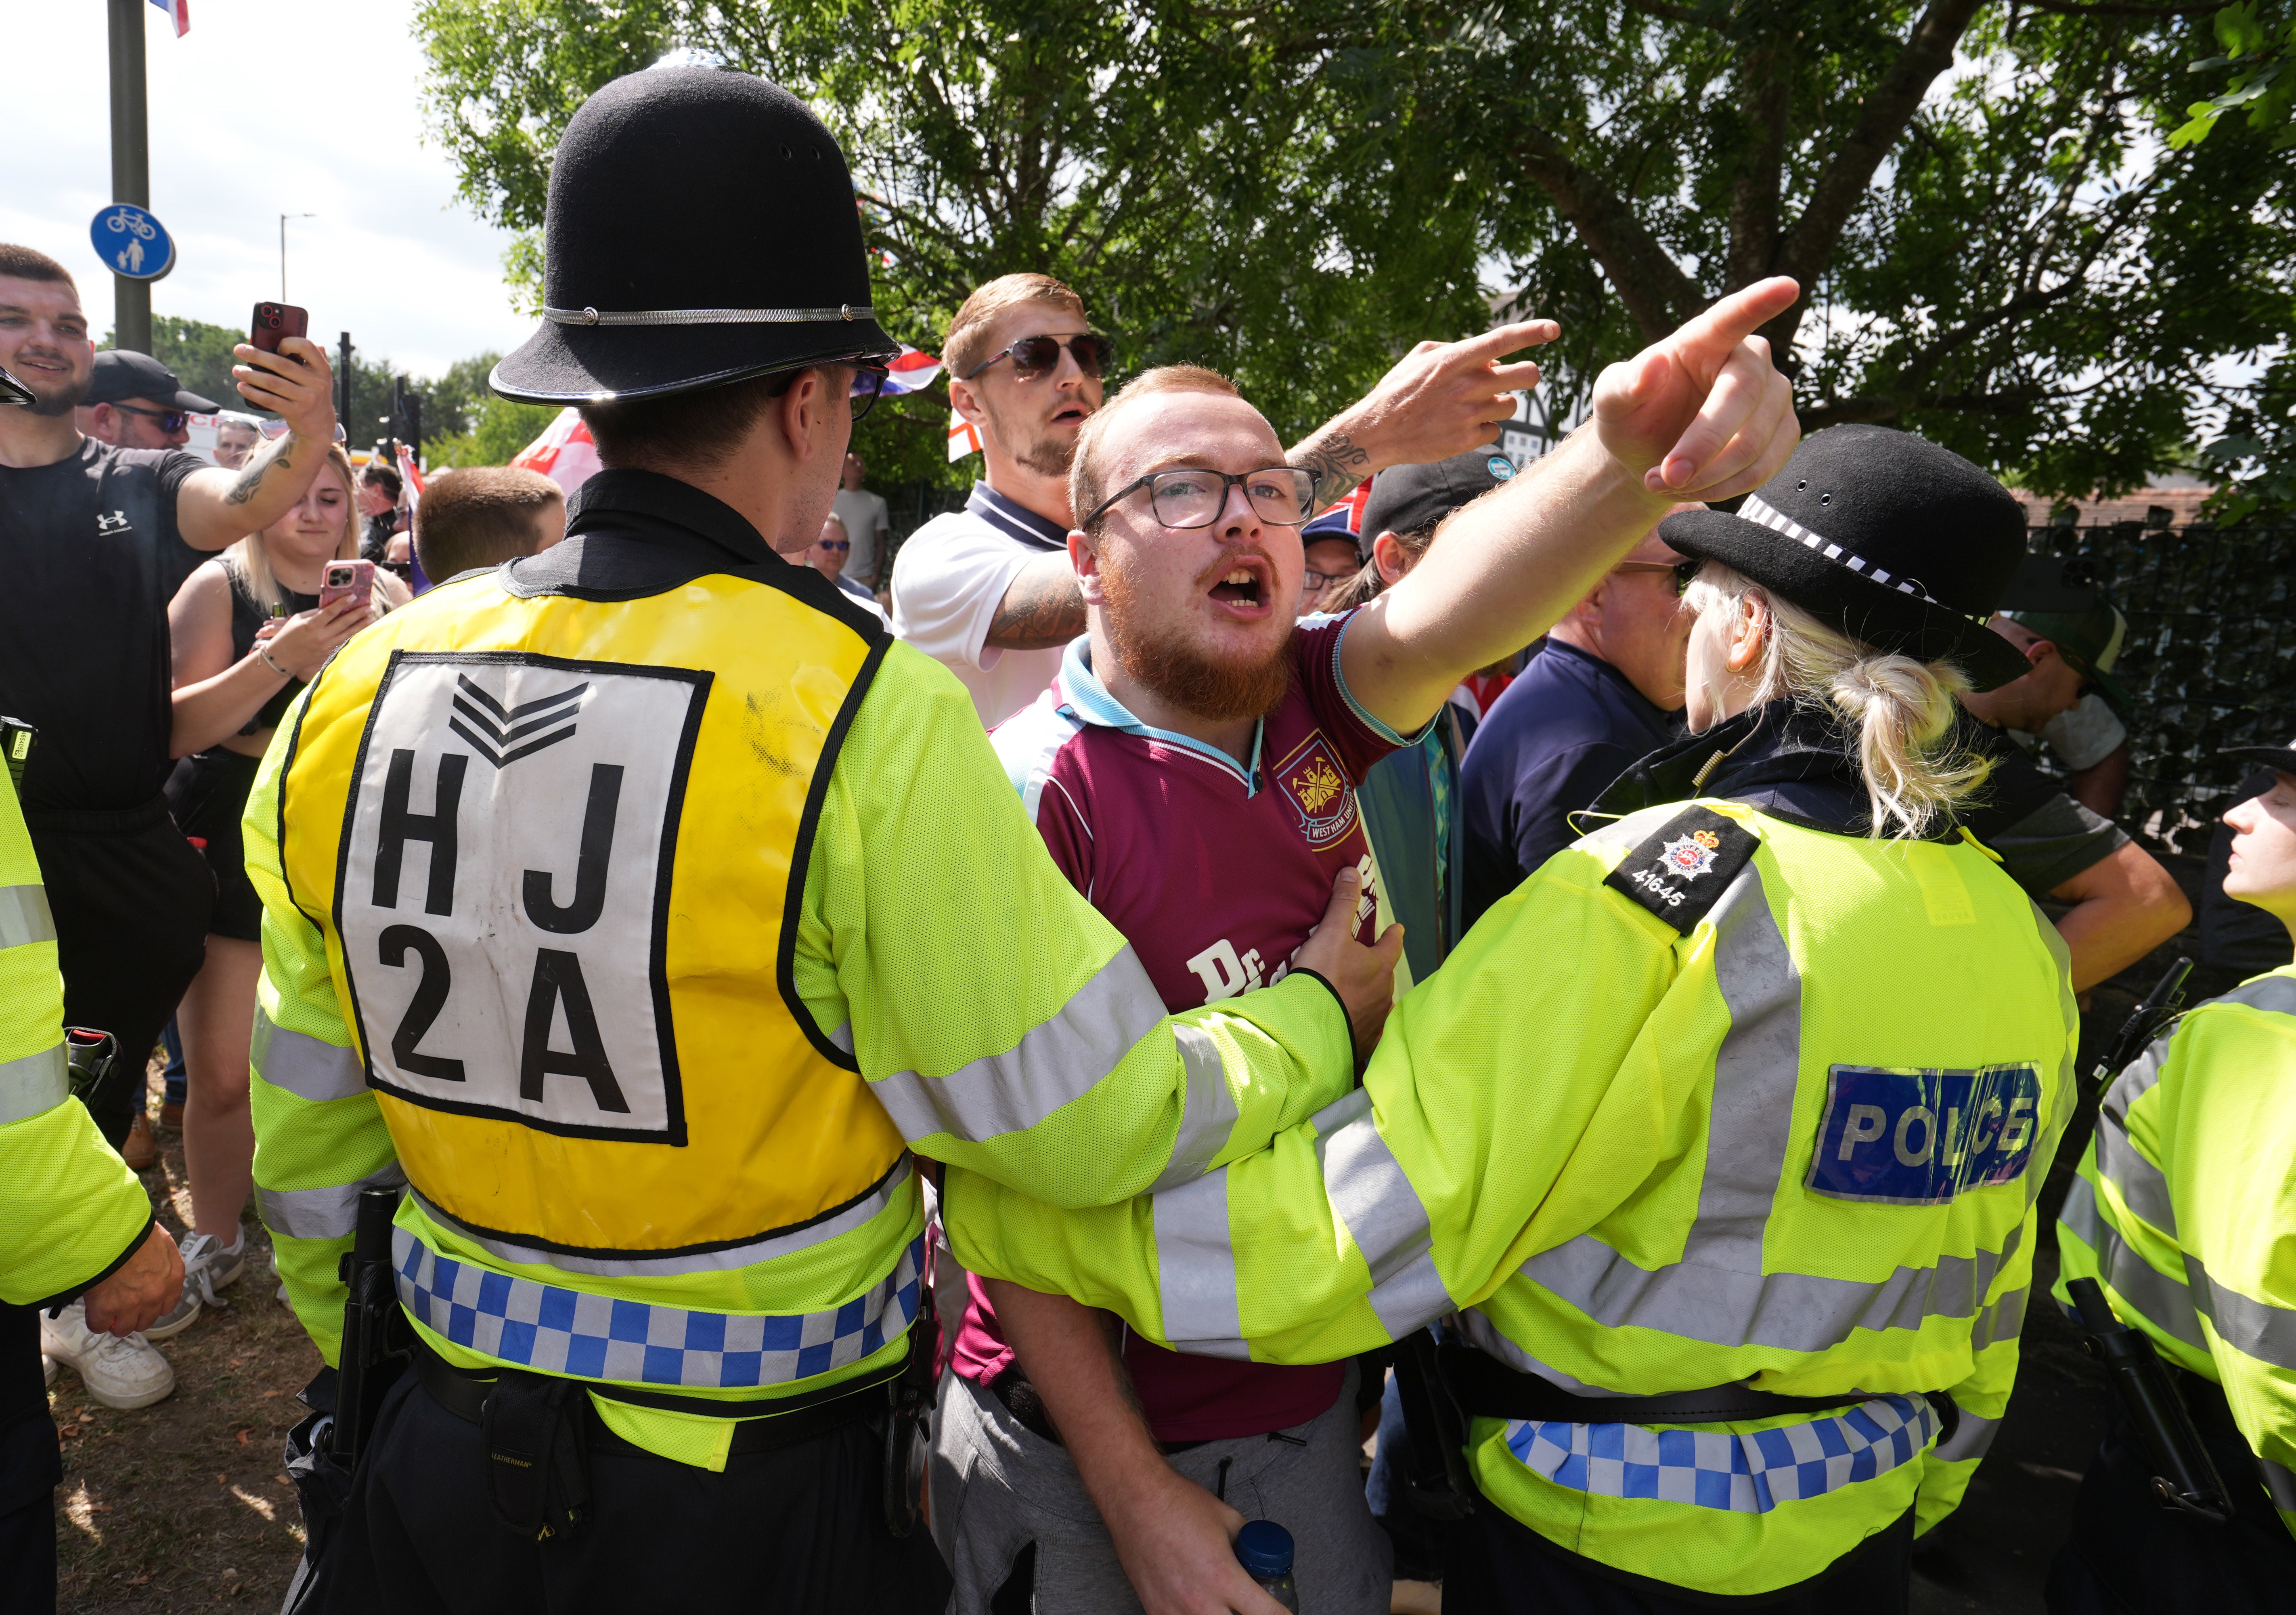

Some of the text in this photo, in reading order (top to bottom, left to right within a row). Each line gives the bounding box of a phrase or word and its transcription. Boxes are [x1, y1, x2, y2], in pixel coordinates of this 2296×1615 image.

[1312, 826, 1330, 838] WEST
[1330, 816, 1346, 833] HAM
[1632, 869, 1686, 906] 41645
[1838, 1097, 2033, 1167] POLCE
